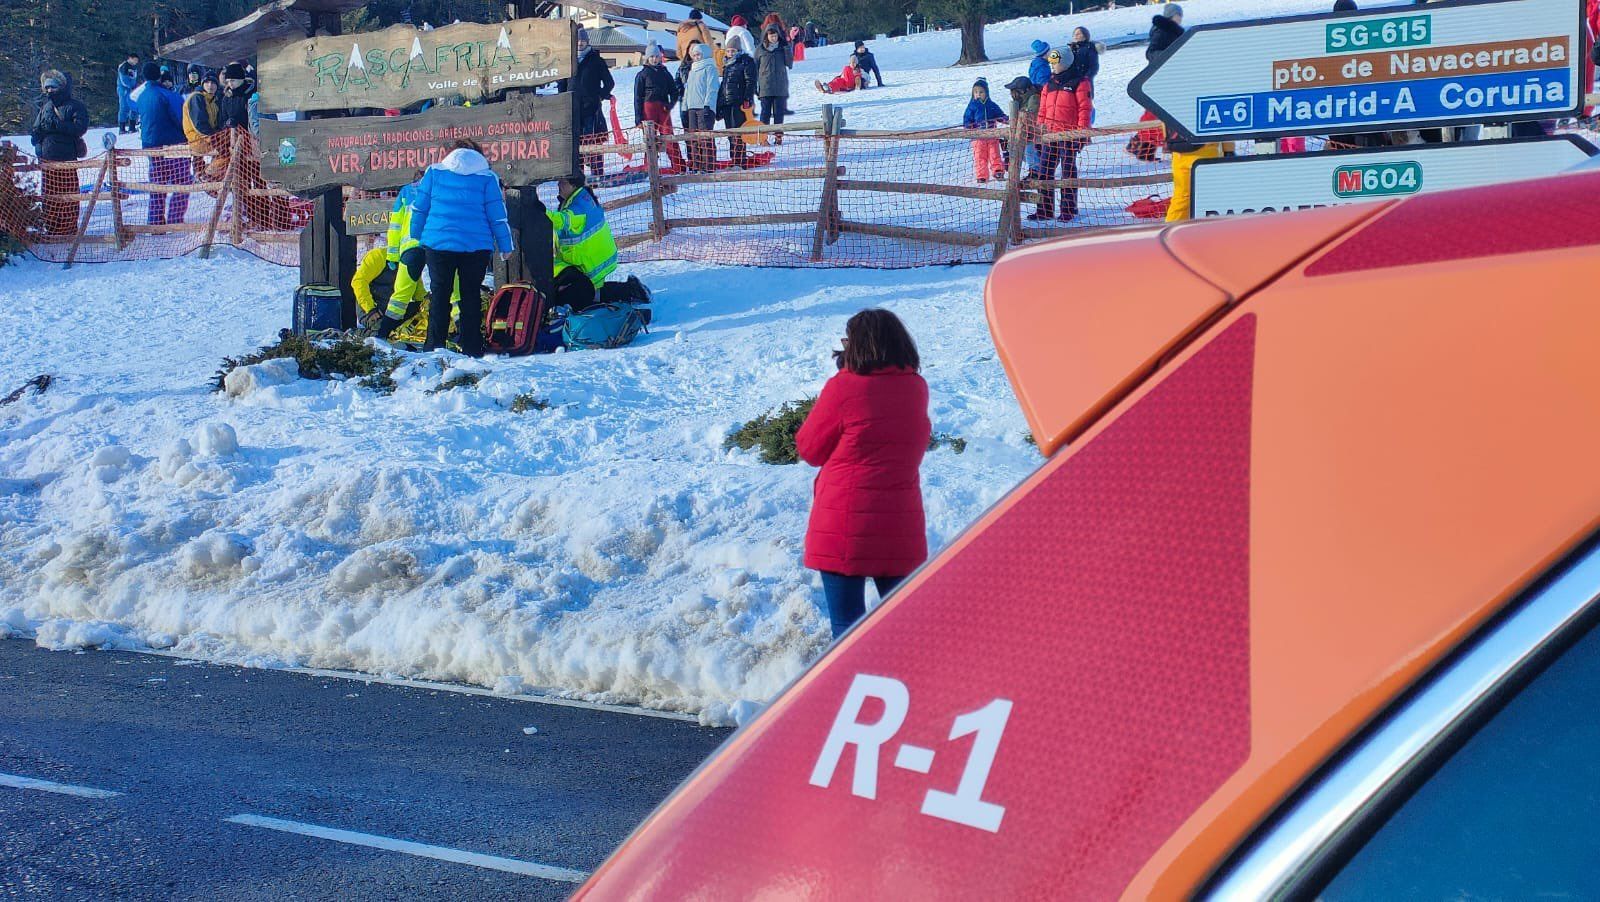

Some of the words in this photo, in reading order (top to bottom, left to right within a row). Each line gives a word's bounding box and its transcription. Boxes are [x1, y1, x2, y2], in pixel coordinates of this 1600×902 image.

[1330, 19, 1427, 48] SG-615
[309, 27, 520, 93] RASCAFRIA
[428, 80, 458, 90] Valle
[492, 75, 505, 84] EL
[509, 68, 559, 81] PAULAR
[1275, 62, 1325, 90] pto.
[1341, 58, 1373, 79] de
[1390, 42, 1565, 76] Navacerrada
[1205, 101, 1247, 125] A-6
[1267, 87, 1416, 123] Madrid-A
[1440, 77, 1565, 110] Coruña
[328, 153, 365, 174] VER,
[370, 146, 447, 171] DISFRUTA
[481, 139, 550, 162] ESPIRAR
[1338, 167, 1417, 193] M604
[809, 673, 1014, 833] R-1
